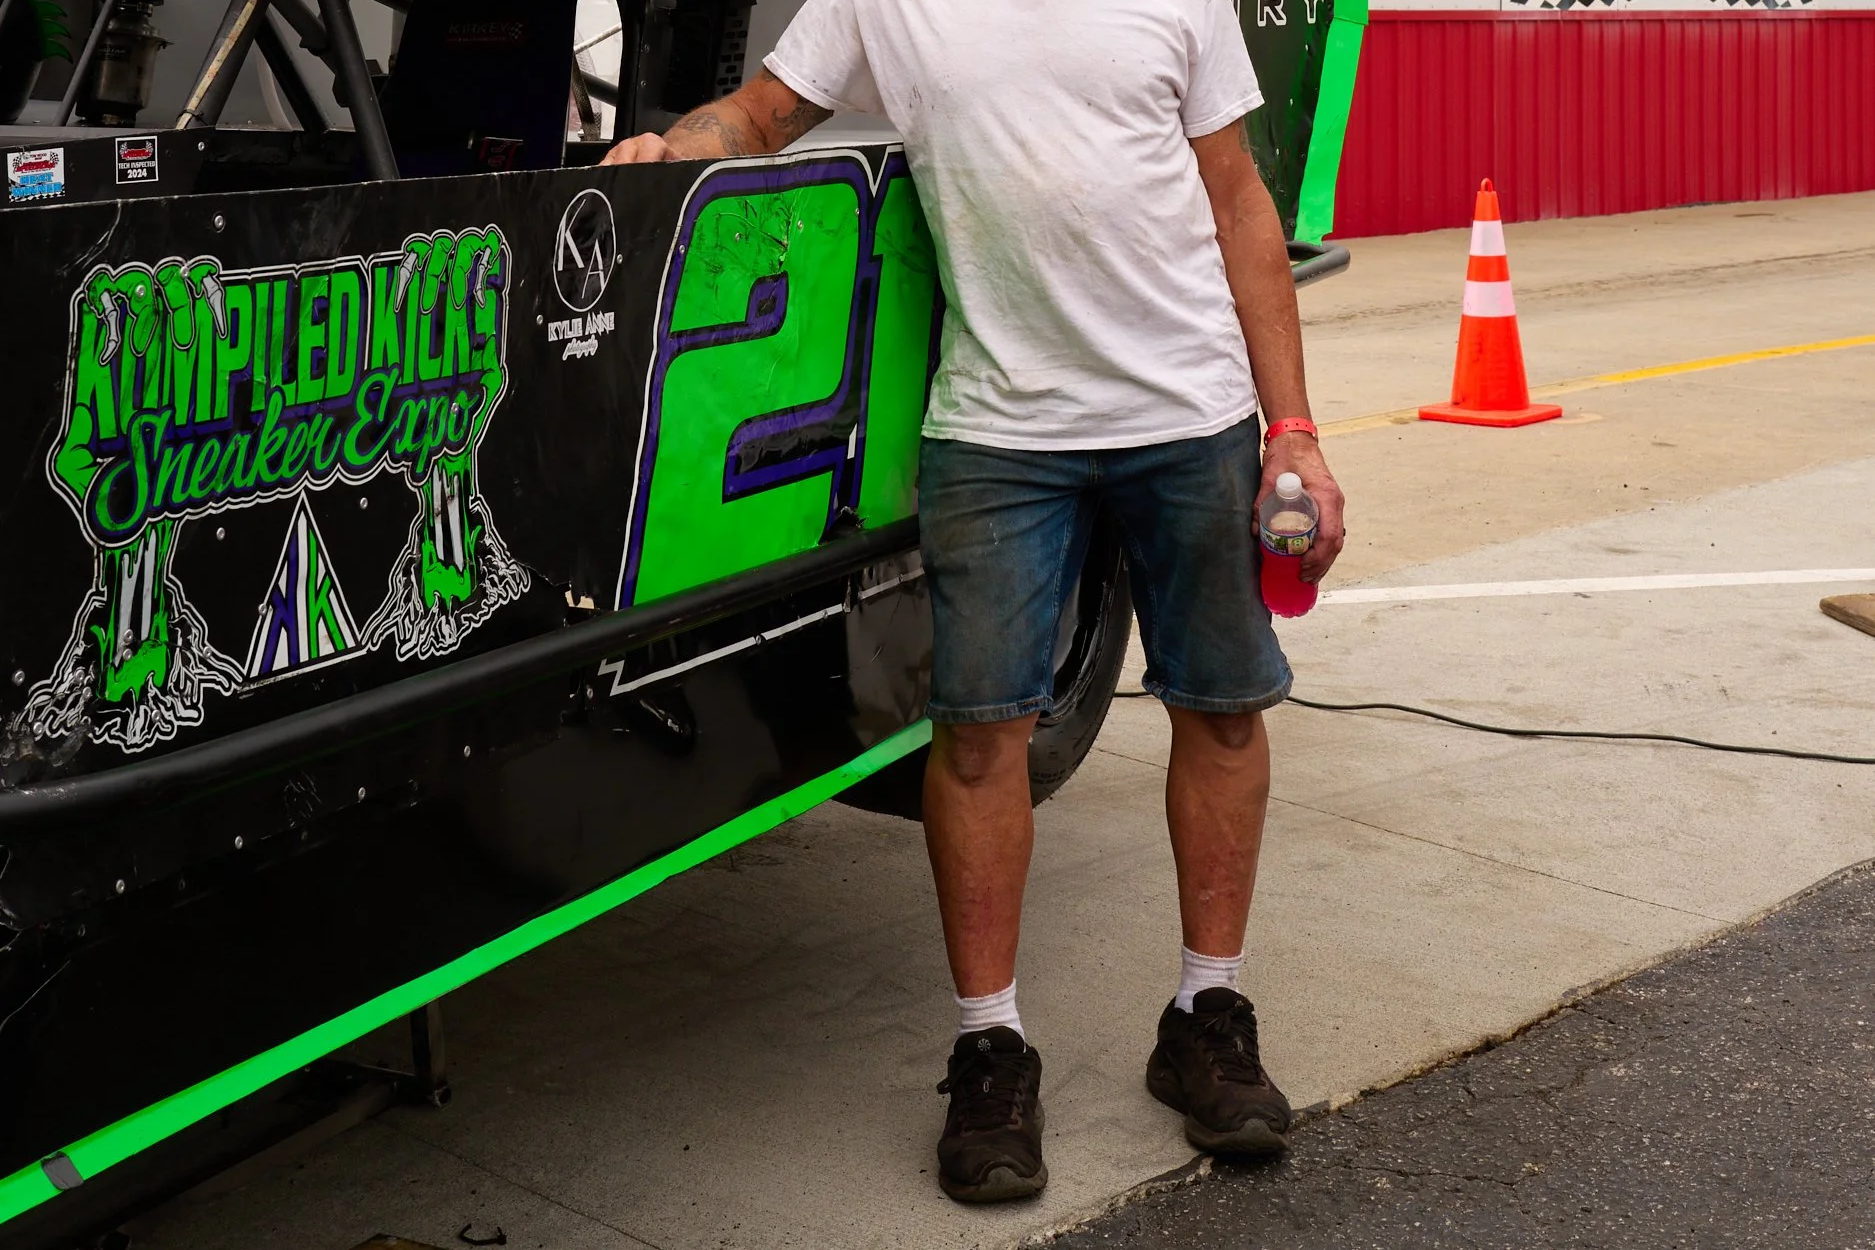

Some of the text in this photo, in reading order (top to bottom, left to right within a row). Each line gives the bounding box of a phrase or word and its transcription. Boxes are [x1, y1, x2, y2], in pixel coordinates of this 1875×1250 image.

[131, 160, 156, 168] INSPECTED
[18, 172, 53, 186] HEAT
[127, 168, 148, 178] 2024
[11, 182, 63, 197] WINNER
[370, 250, 500, 386] KICKS
[548, 310, 615, 342] KYLIE ANNE
[96, 368, 479, 528] Sneaker Expo
